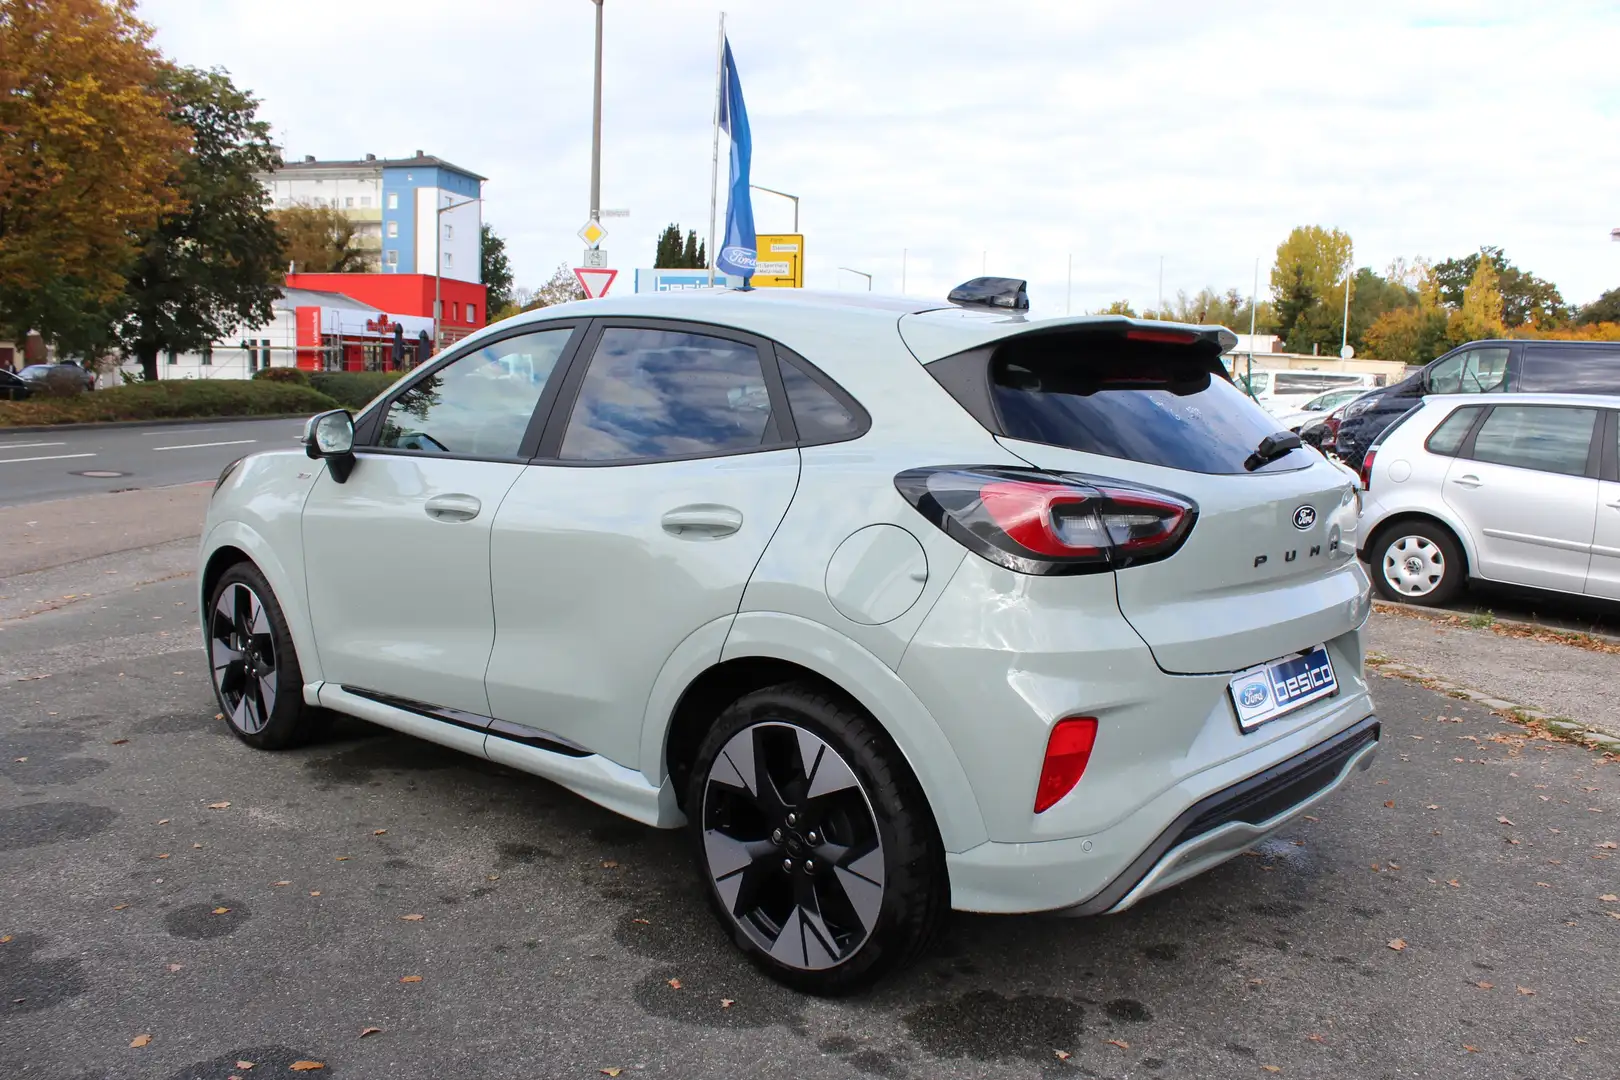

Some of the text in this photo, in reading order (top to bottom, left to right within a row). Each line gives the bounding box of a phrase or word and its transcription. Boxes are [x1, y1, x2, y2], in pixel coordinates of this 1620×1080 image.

[1298, 508, 1315, 526] Ford
[1253, 541, 1339, 569] PUMA
[1269, 662, 1333, 702] besico
[1244, 685, 1265, 706] Ford
